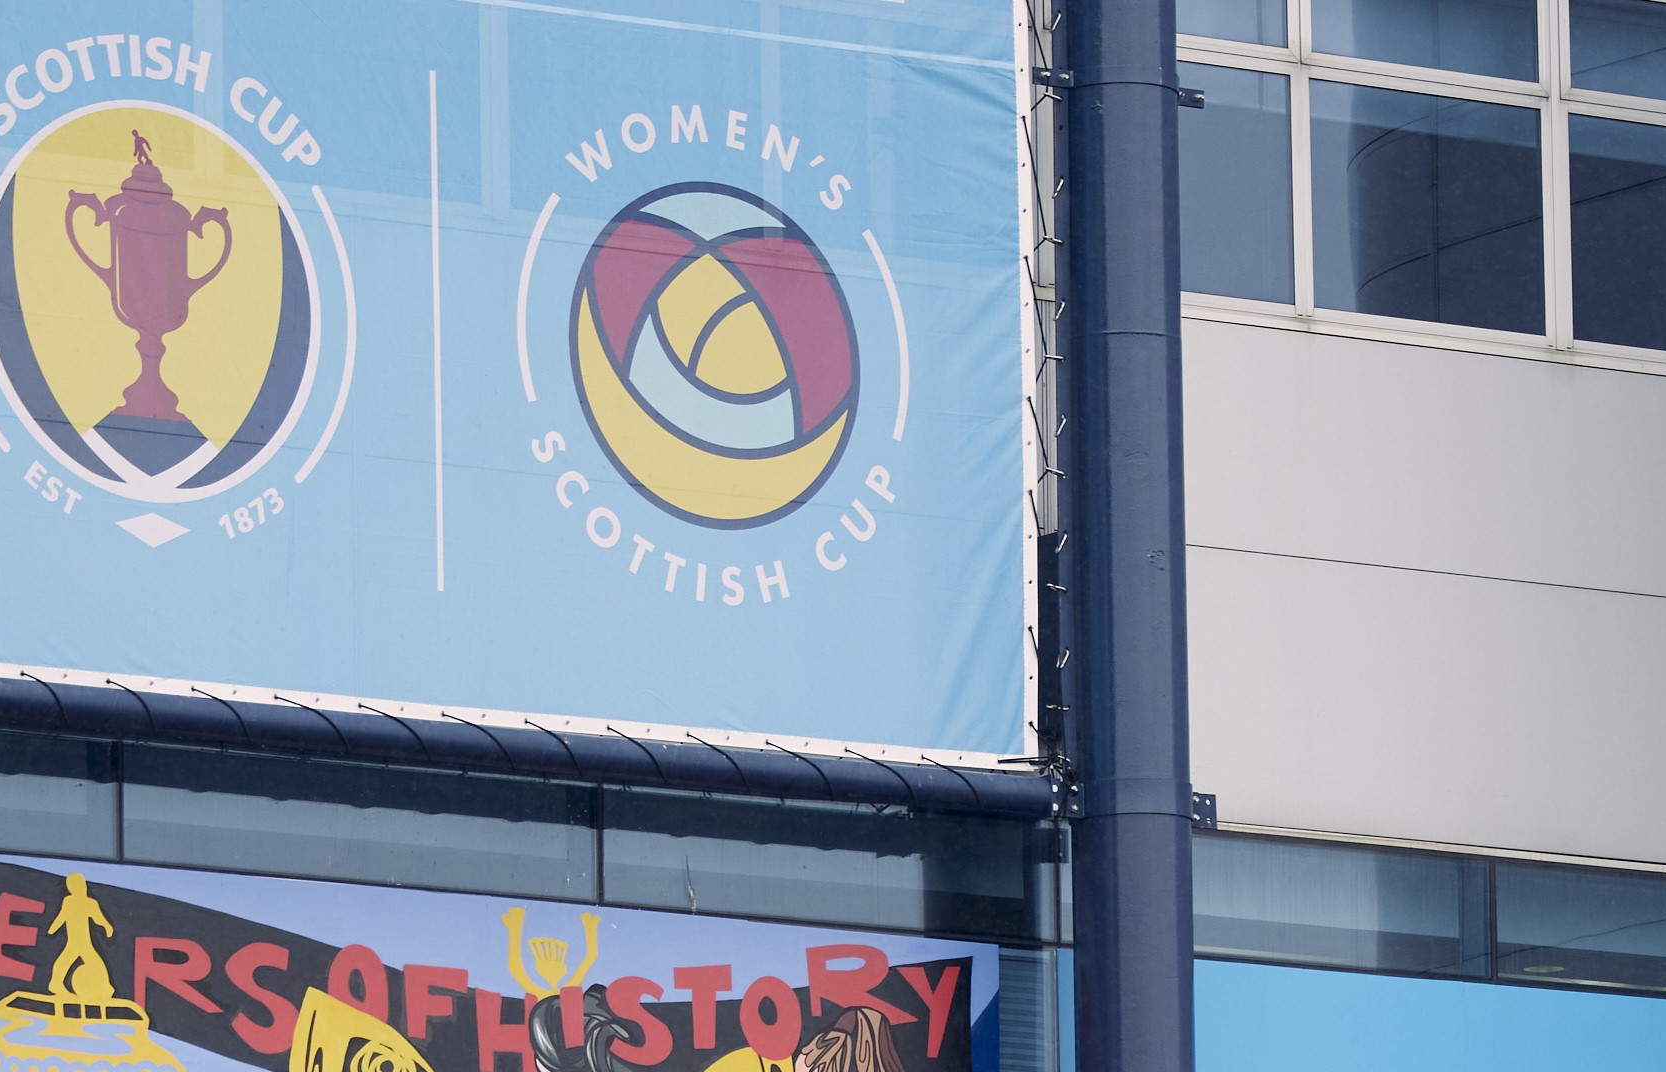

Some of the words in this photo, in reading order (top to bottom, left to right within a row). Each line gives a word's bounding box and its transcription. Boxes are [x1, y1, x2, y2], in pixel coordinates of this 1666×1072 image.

[230, 77, 321, 166] CUP
[565, 105, 851, 210] WOMEN'S
[23, 460, 82, 514] EST
[218, 487, 284, 539] 1873
[531, 431, 790, 606] SCOTTISH
[816, 465, 896, 572] CUP
[327, 944, 469, 1040] OF
